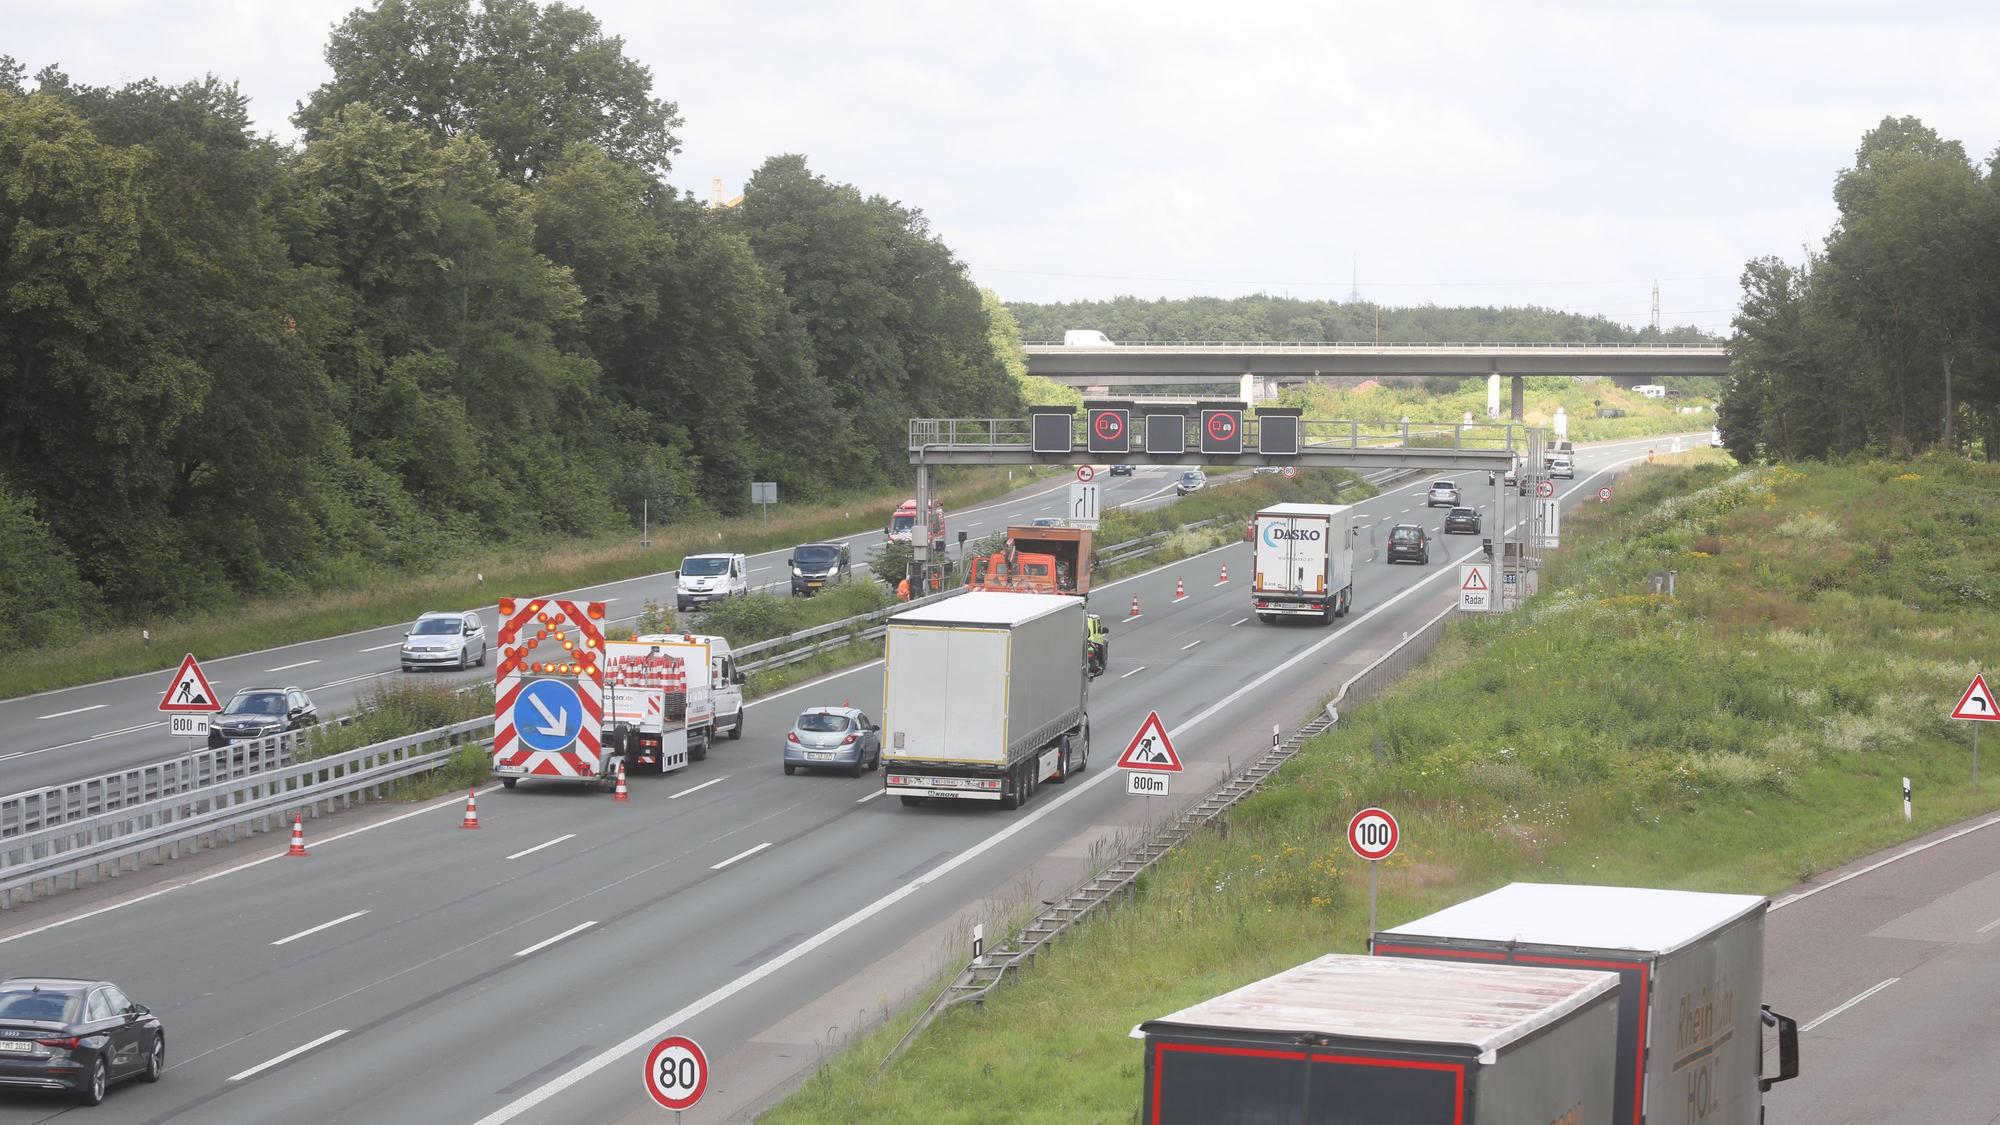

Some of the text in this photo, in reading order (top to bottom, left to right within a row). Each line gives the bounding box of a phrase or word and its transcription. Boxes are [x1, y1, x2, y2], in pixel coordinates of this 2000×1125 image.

[1273, 528, 1320, 541] DASKO
[1464, 594, 1484, 605] Radar
[173, 718, 207, 732] 800 m
[1133, 776, 1163, 792] 800m
[1359, 823, 1389, 846] 100
[660, 1056, 695, 1090] 80
